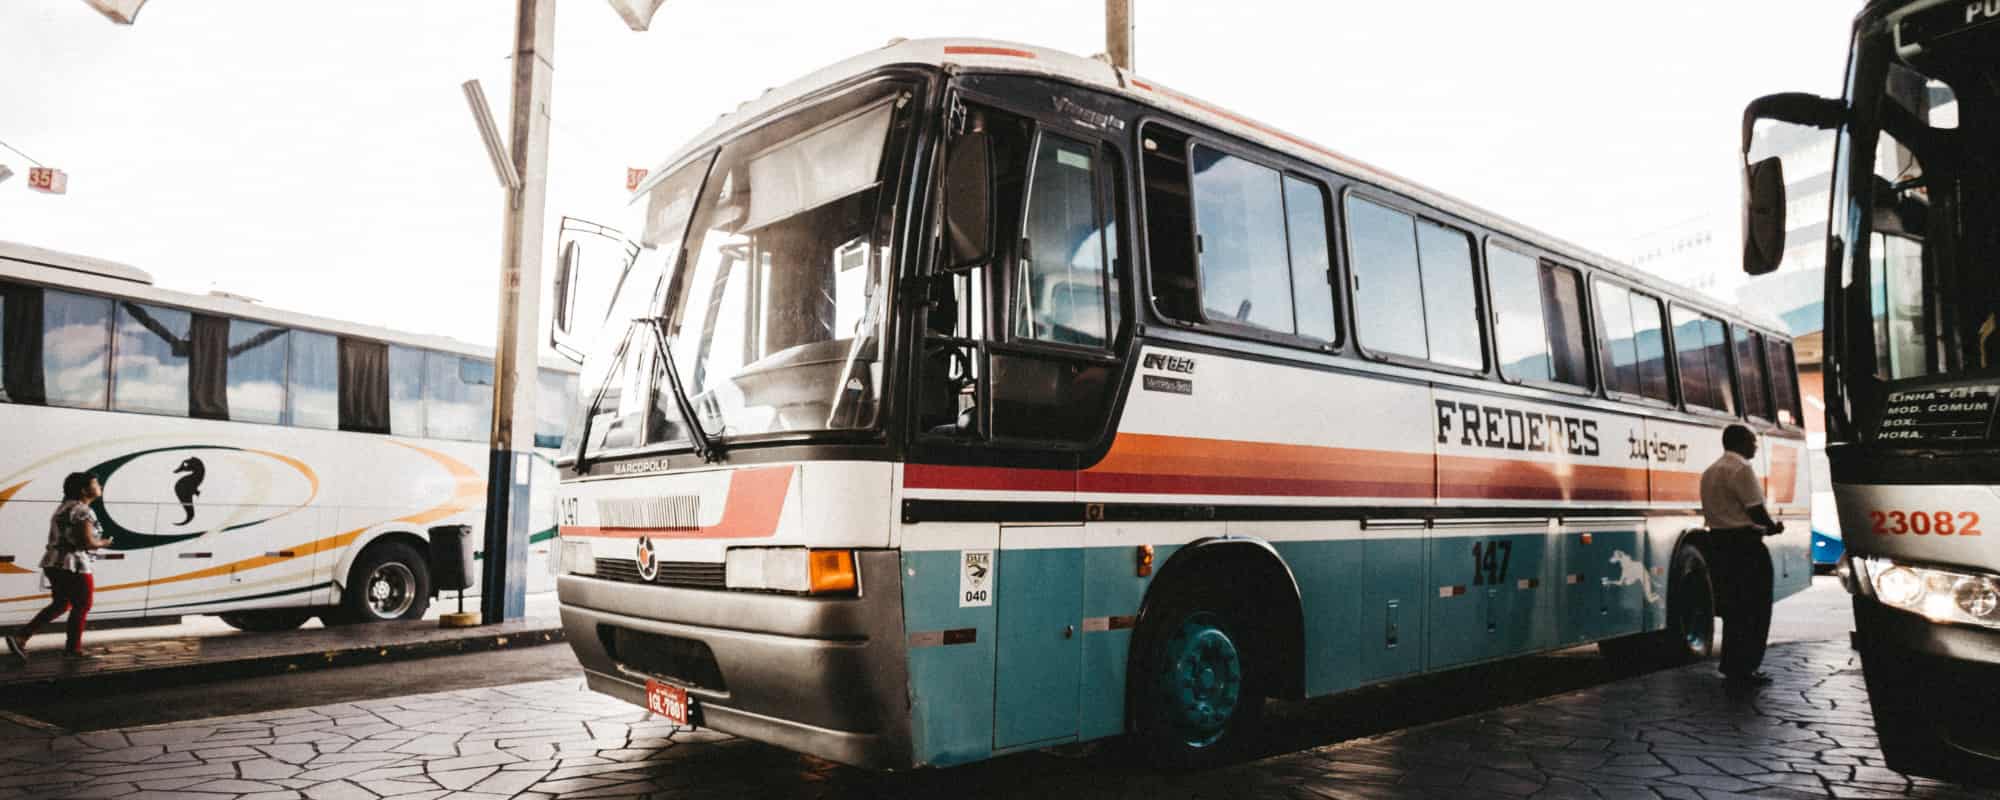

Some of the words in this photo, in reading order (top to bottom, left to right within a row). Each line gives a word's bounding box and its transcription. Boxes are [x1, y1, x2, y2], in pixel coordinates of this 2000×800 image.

[31, 171, 50, 186] 35
[1927, 402, 1988, 411] COMUM
[614, 460, 668, 473] MARCOPOLO
[1871, 510, 1983, 536] 23082
[1472, 541, 1512, 586] 147
[966, 590, 987, 602] 040
